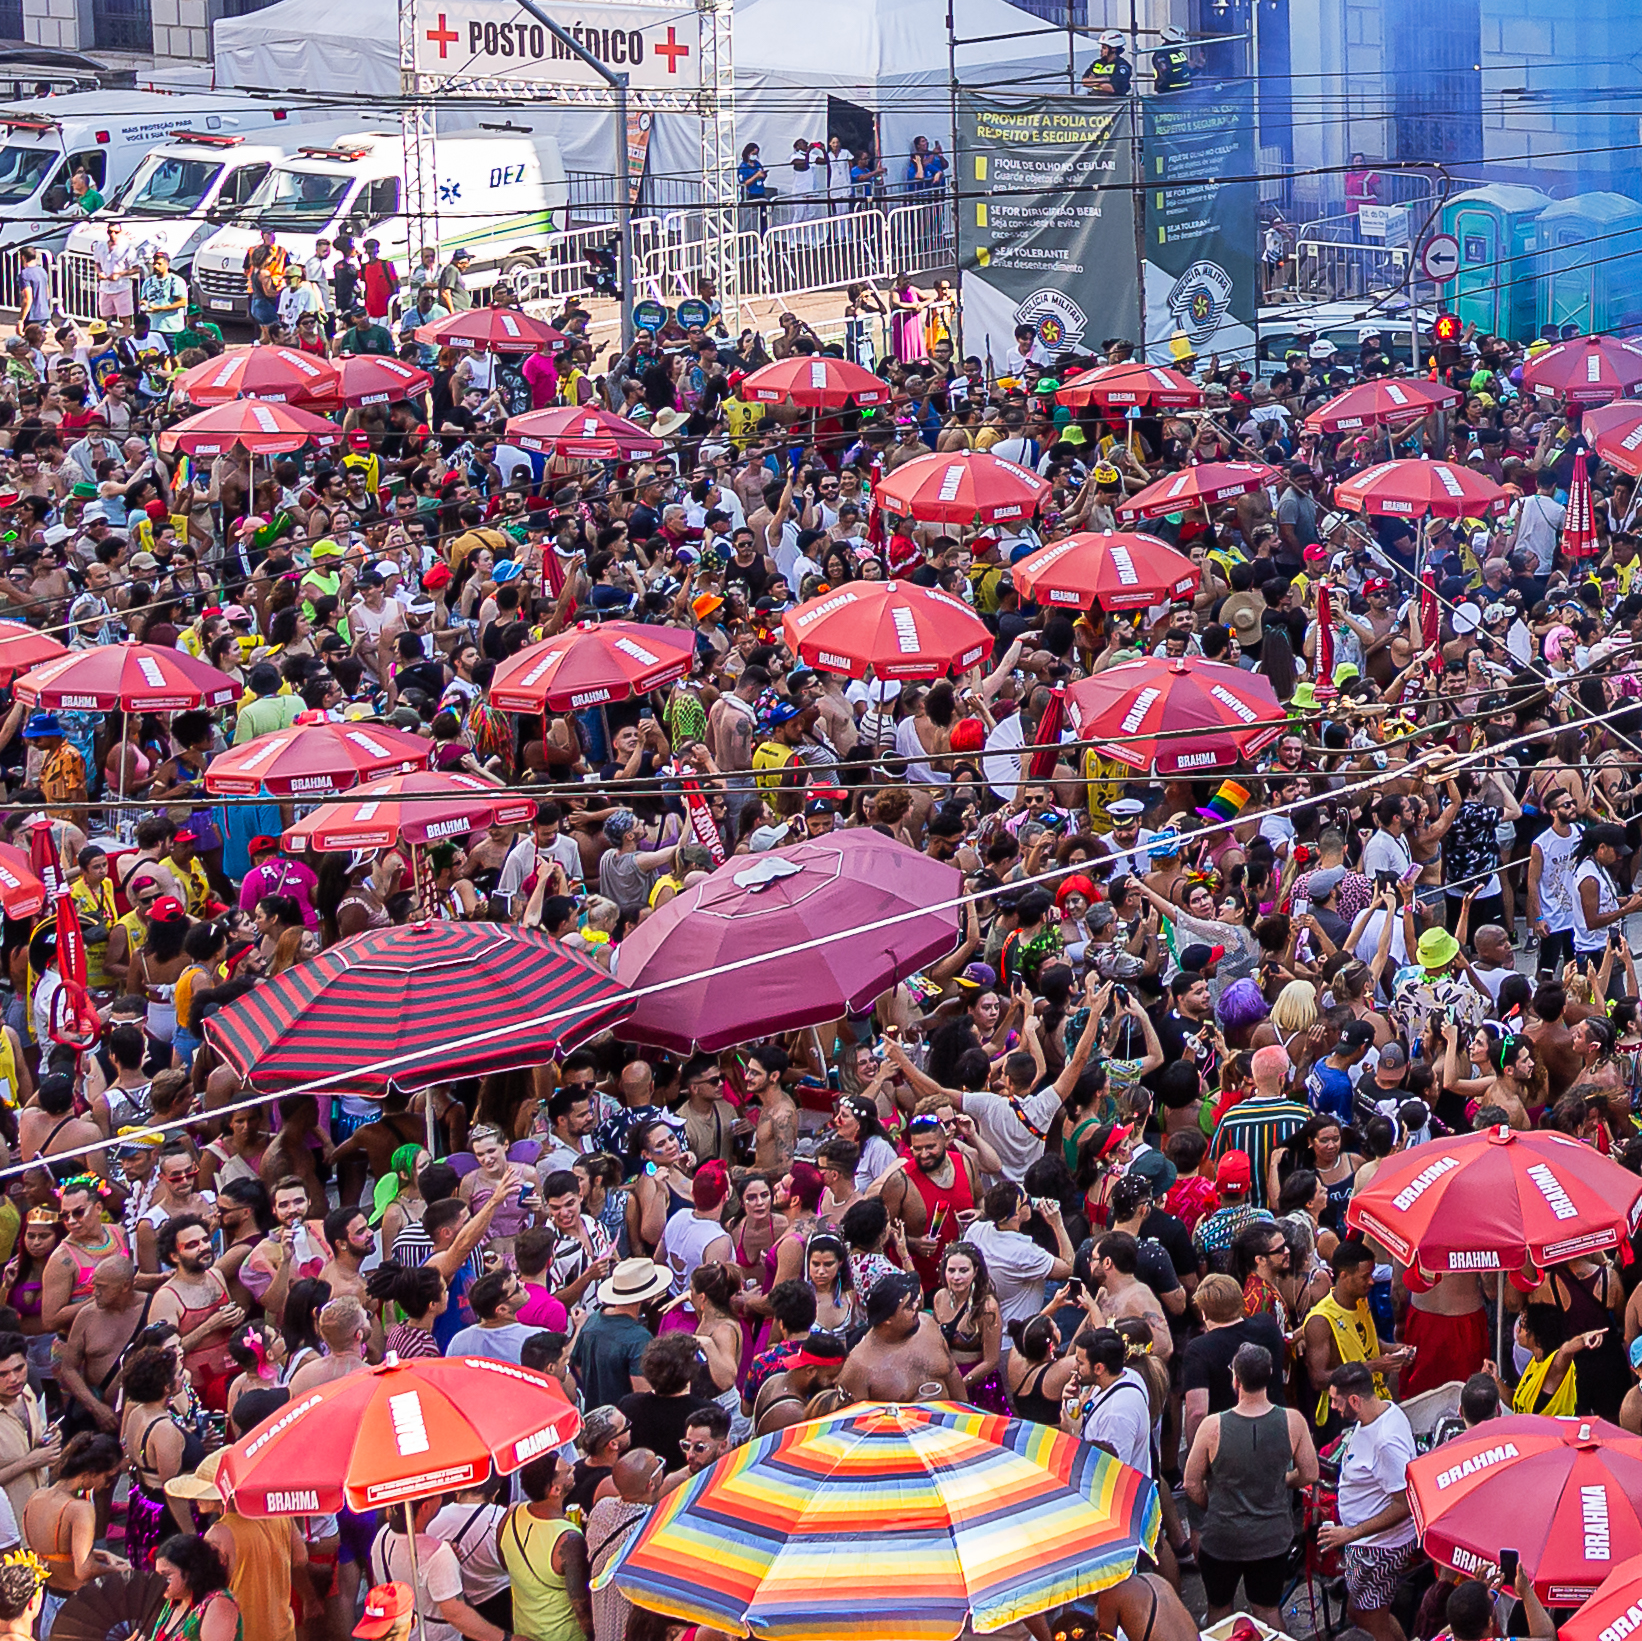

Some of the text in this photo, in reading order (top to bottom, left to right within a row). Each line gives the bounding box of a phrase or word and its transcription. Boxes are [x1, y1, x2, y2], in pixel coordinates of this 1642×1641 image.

[469, 20, 644, 66] POSTO MÉDICO
[1042, 115, 1050, 126] A
[1053, 115, 1086, 128] FOLIA
[1032, 130, 1040, 142] E
[490, 164, 526, 188] DEZ
[990, 206, 1020, 216] SE FOR
[991, 218, 1007, 229] Seja
[1014, 249, 1069, 259] TOLERANTE
[1174, 266, 1228, 301] POLÍCIA MILITAR
[1020, 294, 1081, 325] POLÍCIA MILITAR
[1028, 541, 1078, 571] BRAHMA
[798, 592, 857, 627] BRAHMA
[891, 606, 921, 653] BRAHMA
[818, 651, 851, 670] BRAHMA
[58, 693, 99, 710] BRAHMA
[571, 688, 611, 707] BRAHMA
[1210, 684, 1258, 724] BRAHMA
[1121, 687, 1160, 733] BRAHMA
[1177, 751, 1217, 769] BRAHMA
[291, 775, 336, 791] BRAHMA
[424, 816, 472, 840] BRAHMA
[1392, 1156, 1460, 1211] BRAHMA
[1526, 1163, 1578, 1220] BRAHMA
[1448, 1251, 1500, 1269] BRAHMA
[515, 1424, 560, 1462] BRAHMA
[1436, 1443, 1519, 1490] BRAHMA
[266, 1490, 319, 1512] BRAHMA
[1580, 1485, 1610, 1560] BRAHMA
